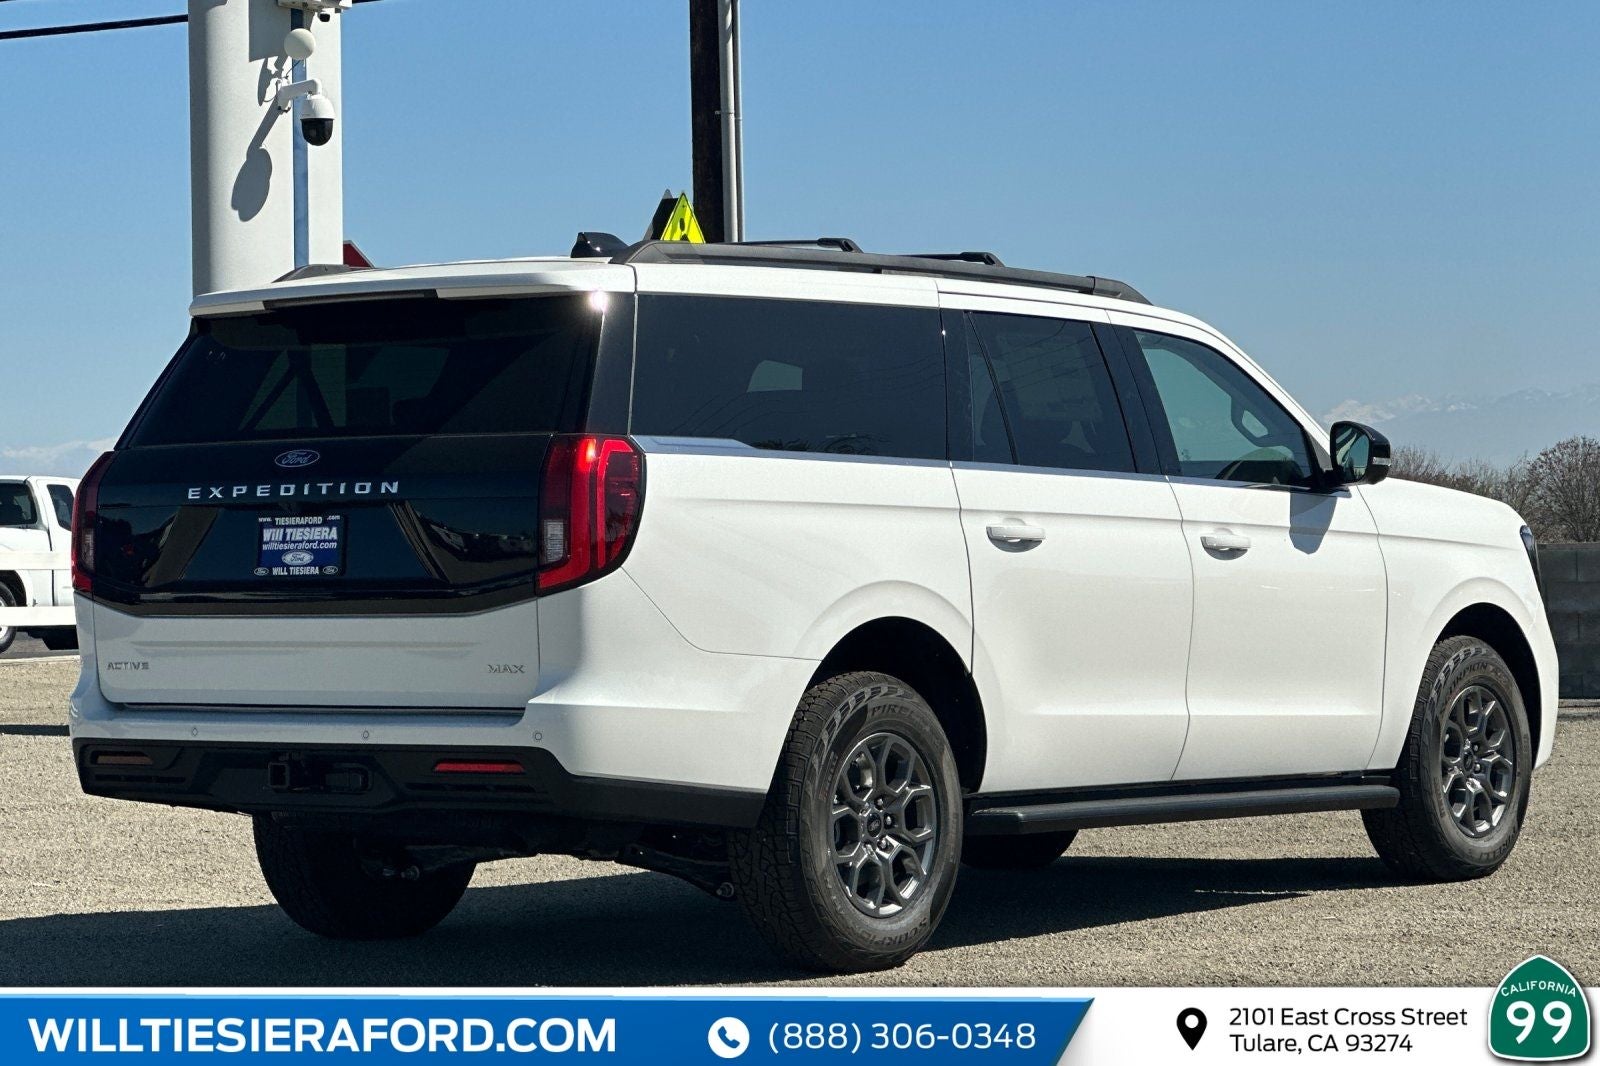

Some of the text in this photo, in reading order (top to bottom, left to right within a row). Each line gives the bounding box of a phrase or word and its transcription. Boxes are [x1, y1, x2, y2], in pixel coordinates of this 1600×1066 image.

[280, 451, 313, 466] Ford
[187, 481, 399, 499] EXPEDITION
[274, 516, 323, 526] TIESIERAFORD
[285, 526, 338, 542] TIESIERA
[262, 540, 338, 551] willtiesieraford.com
[272, 566, 320, 576] WILL TIESIERA
[107, 661, 150, 671] ACTIVE
[487, 663, 526, 674] MAX
